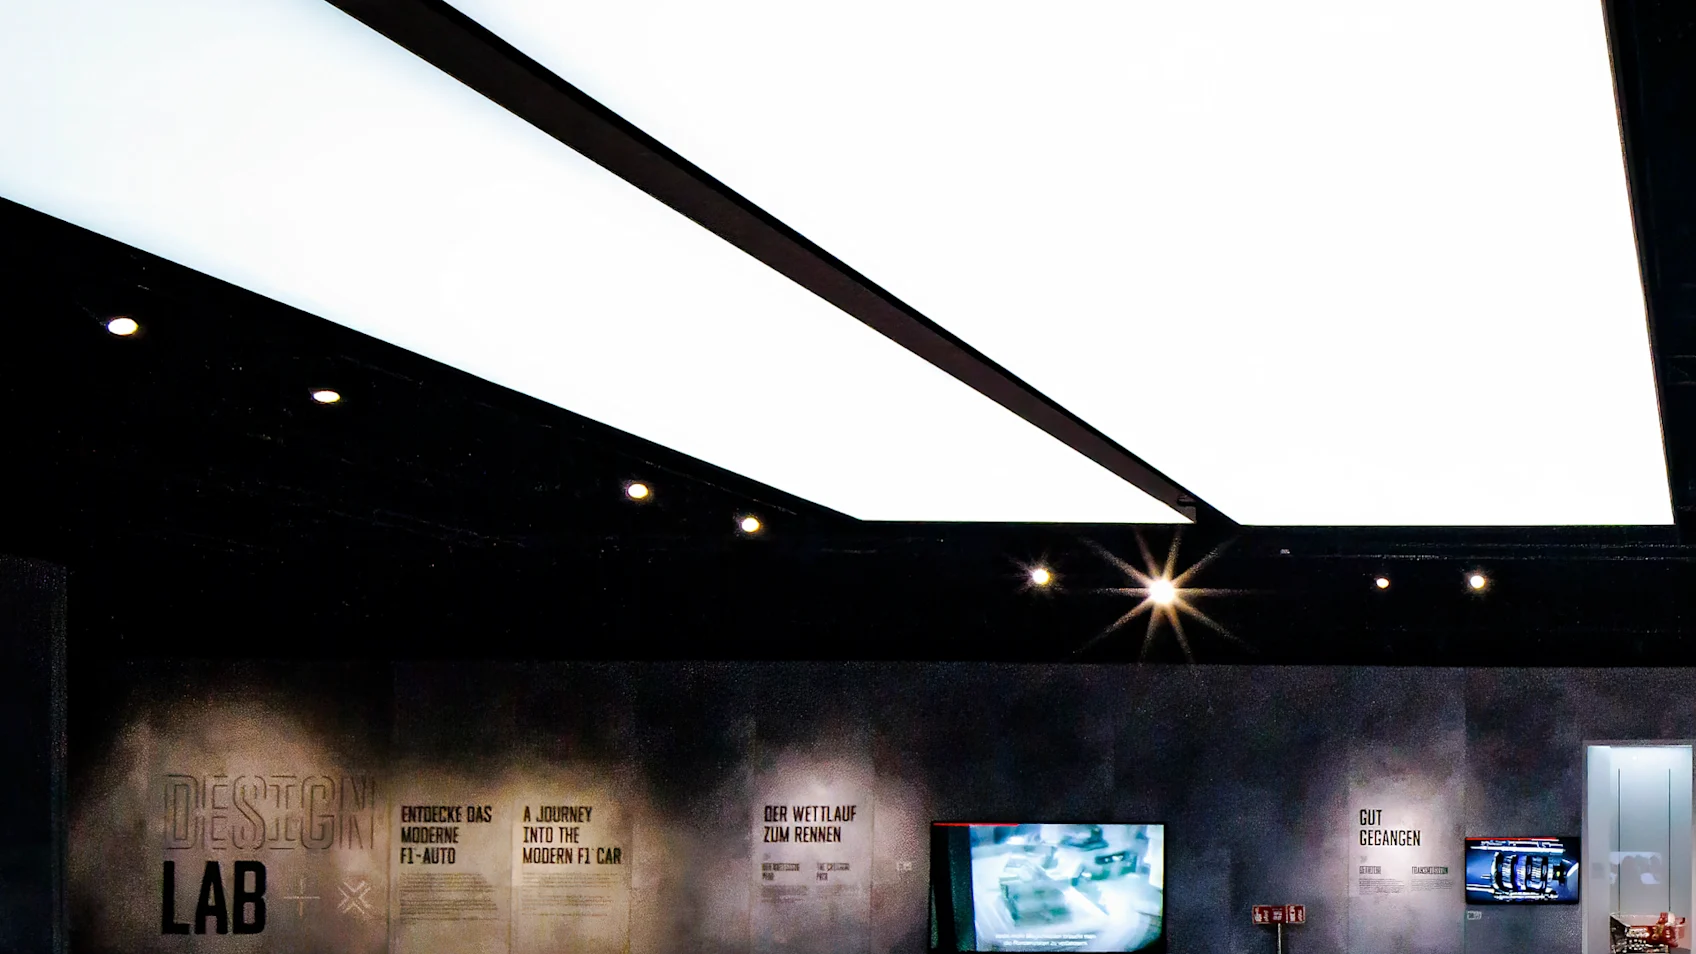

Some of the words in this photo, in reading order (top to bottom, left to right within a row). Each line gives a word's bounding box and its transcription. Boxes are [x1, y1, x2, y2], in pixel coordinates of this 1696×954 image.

[165, 774, 375, 850] DESIGN
[401, 805, 463, 823] ENTDECKE
[467, 805, 492, 823] DAS
[523, 806, 531, 823] A
[536, 806, 592, 823] JOURNEY
[764, 805, 787, 822] DER
[793, 805, 857, 822] WETTLAUF
[1360, 809, 1382, 826] GUT
[401, 826, 459, 844] MODERNE
[523, 826, 553, 844] INTO
[558, 826, 580, 844] THE
[763, 826, 789, 843] ZUM
[794, 826, 841, 843] RENNEN
[1360, 829, 1421, 846] GEGANGEN
[400, 847, 456, 865] F1-AUTO
[522, 847, 573, 865] MODERN
[577, 847, 591, 865] F1
[596, 847, 623, 865] CAR
[161, 860, 267, 935] LAB
